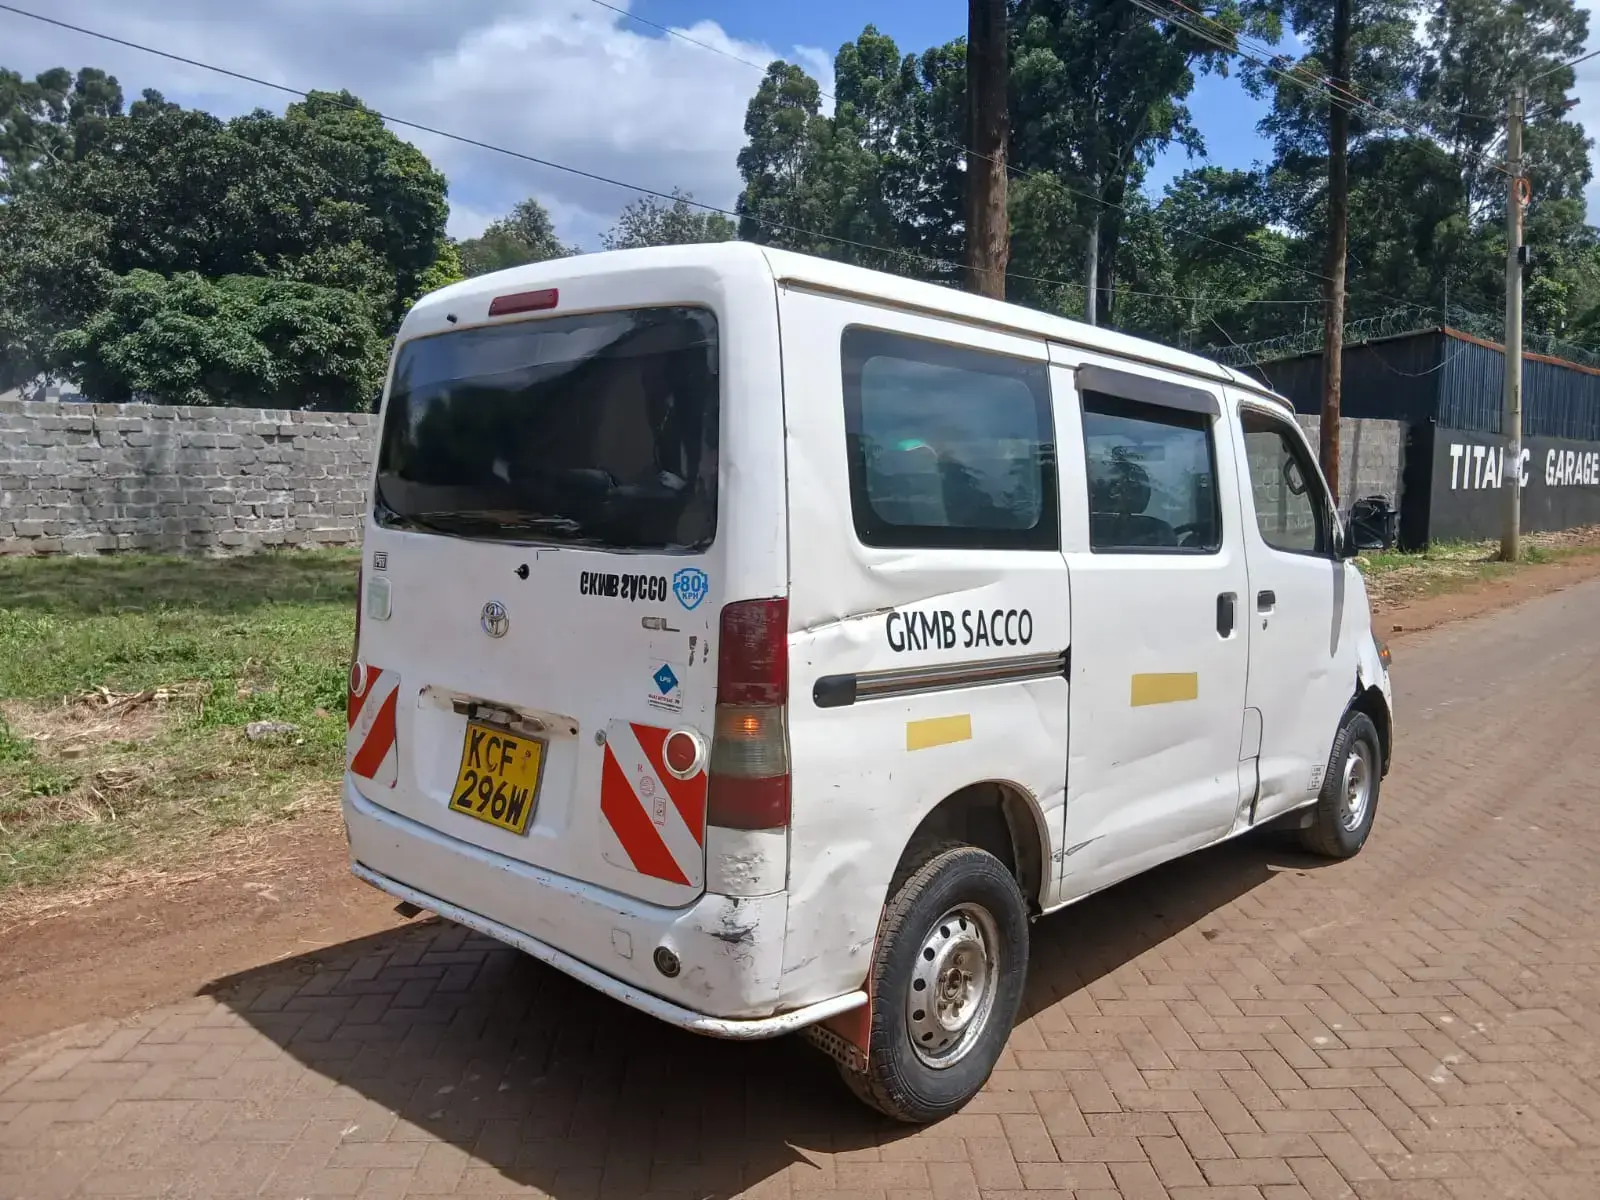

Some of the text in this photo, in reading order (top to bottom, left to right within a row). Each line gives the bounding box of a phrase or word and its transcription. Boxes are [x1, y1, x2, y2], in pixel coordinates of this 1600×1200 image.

[1450, 443, 1599, 490] TITAC GARAGE
[679, 575, 702, 592] 80
[681, 591, 699, 600] KPH
[886, 608, 1033, 653] GKMB SACCO
[466, 728, 518, 777] KCF
[456, 769, 529, 826] 296W
